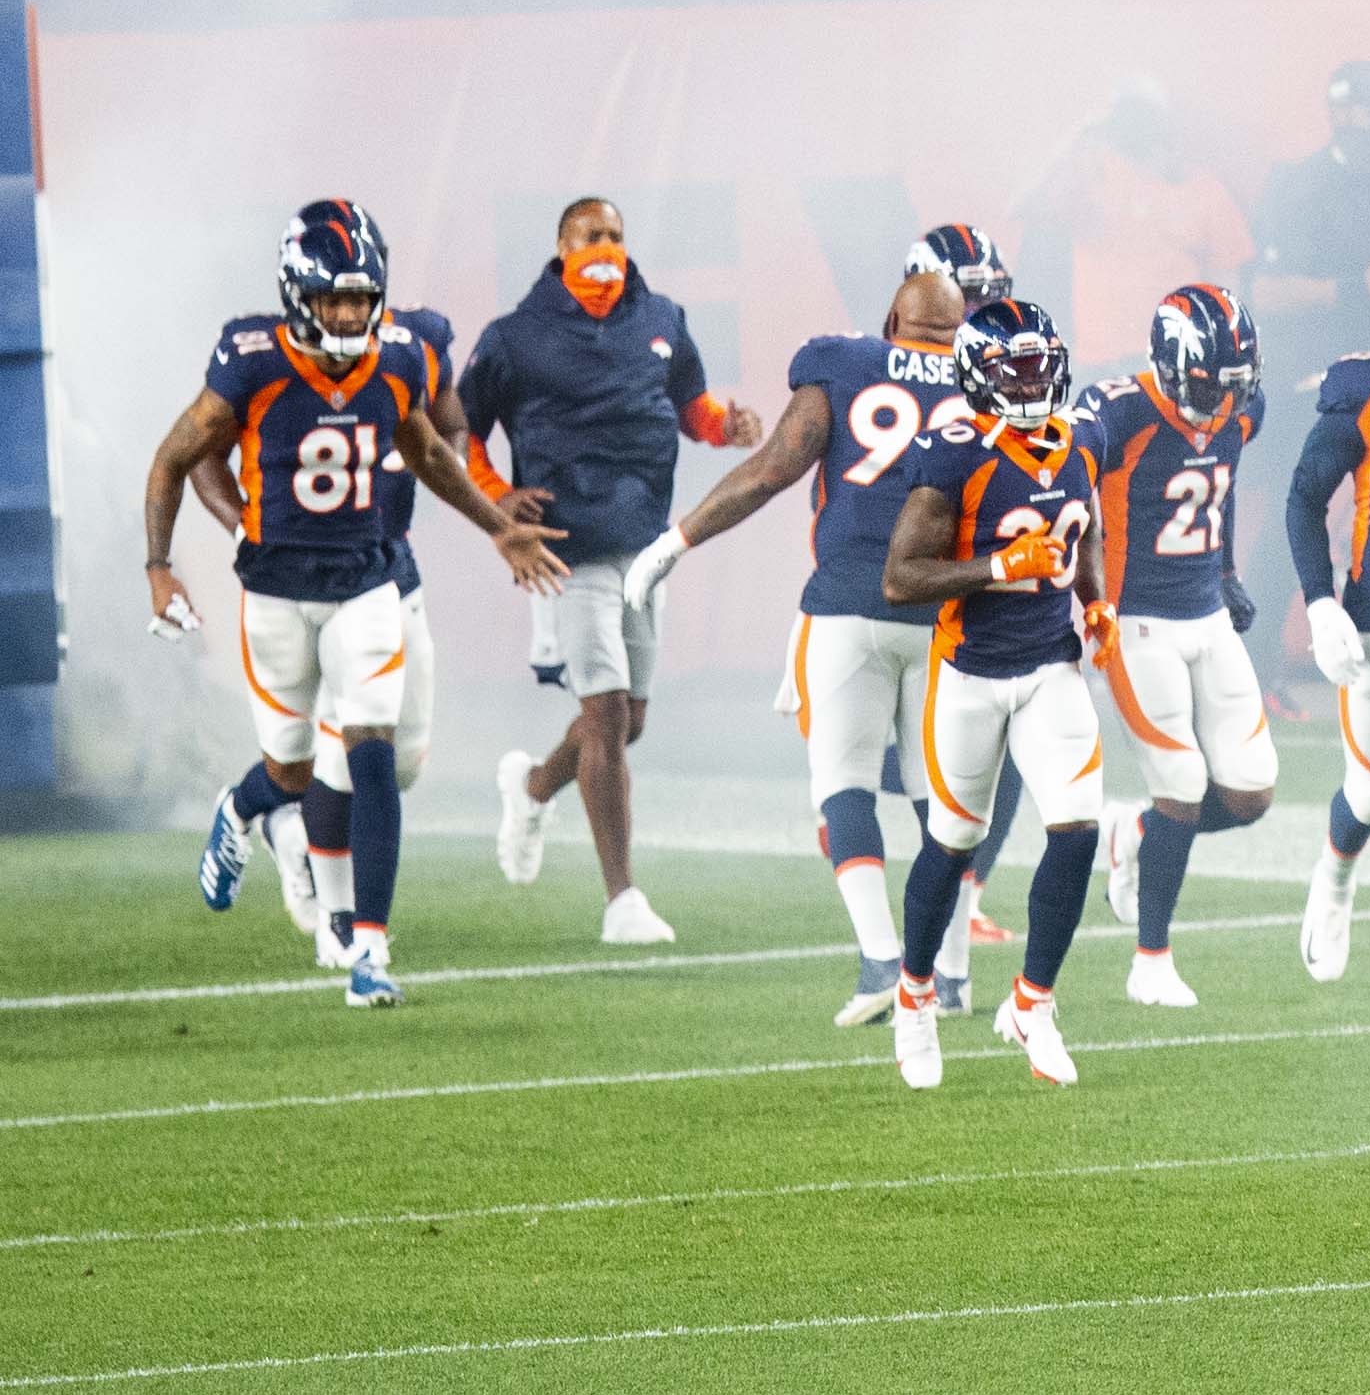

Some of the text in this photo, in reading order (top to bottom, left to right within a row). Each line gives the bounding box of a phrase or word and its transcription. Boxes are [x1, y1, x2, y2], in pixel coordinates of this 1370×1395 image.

[887, 348, 956, 386] CASE
[294, 426, 376, 514] 81
[843, 383, 977, 488] 9
[984, 499, 1091, 593] 20
[1154, 461, 1231, 556] 21
